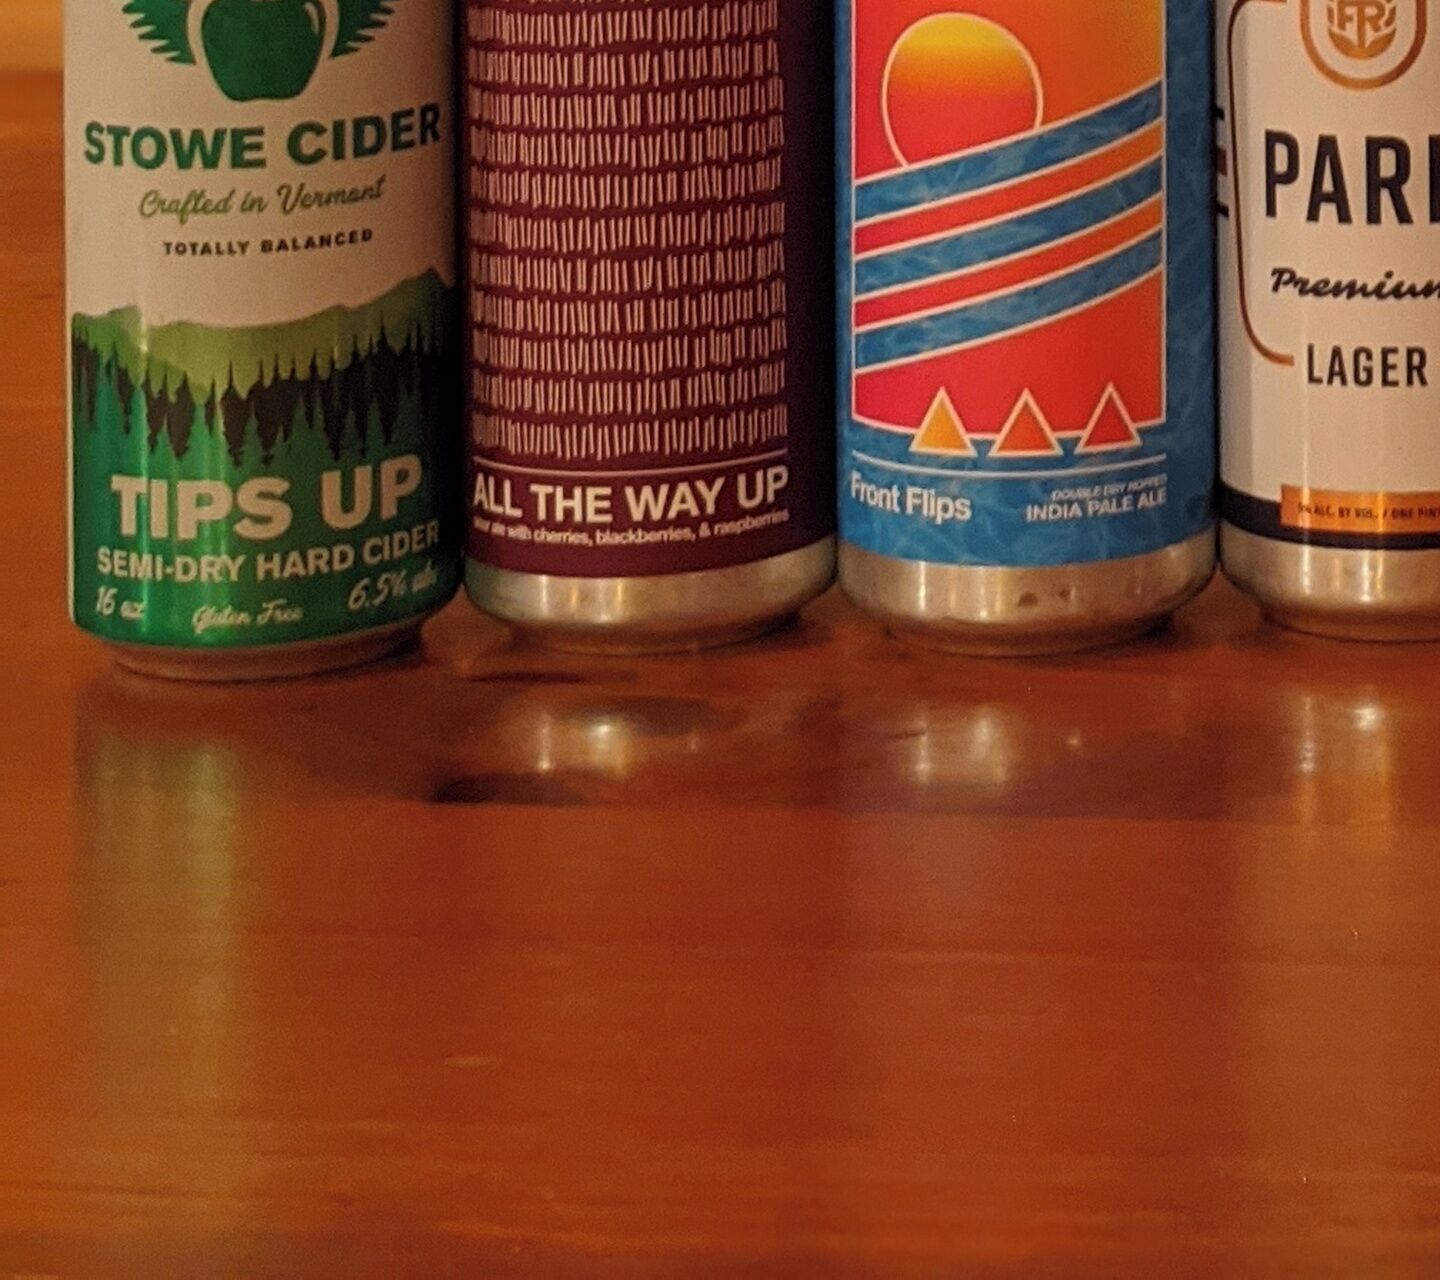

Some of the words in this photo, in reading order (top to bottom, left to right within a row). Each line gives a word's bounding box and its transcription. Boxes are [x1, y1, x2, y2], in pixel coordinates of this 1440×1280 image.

[84, 120, 267, 170] STOWE
[287, 101, 442, 167] CIDER
[139, 187, 235, 225] Crafted
[241, 187, 268, 213] in
[278, 174, 388, 215] Vermont
[164, 241, 250, 256] TOTALLY
[260, 228, 374, 254] BALANCED
[1306, 342, 1429, 388] LAGER
[111, 474, 293, 541] TIPS
[321, 453, 423, 531] UP
[473, 472, 523, 518] ALL
[530, 483, 613, 523] THE
[625, 476, 726, 522] WAY
[736, 464, 789, 510] UP
[851, 470, 899, 514] Front
[906, 484, 973, 525] Flips
[1026, 501, 1083, 522] INDIA
[1087, 494, 1134, 517] PALE
[1138, 487, 1168, 510] ALE
[97, 545, 247, 583] SEMI-DRY
[256, 544, 356, 580] HARD
[362, 519, 440, 565] CIDER
[96, 585, 118, 616] 16
